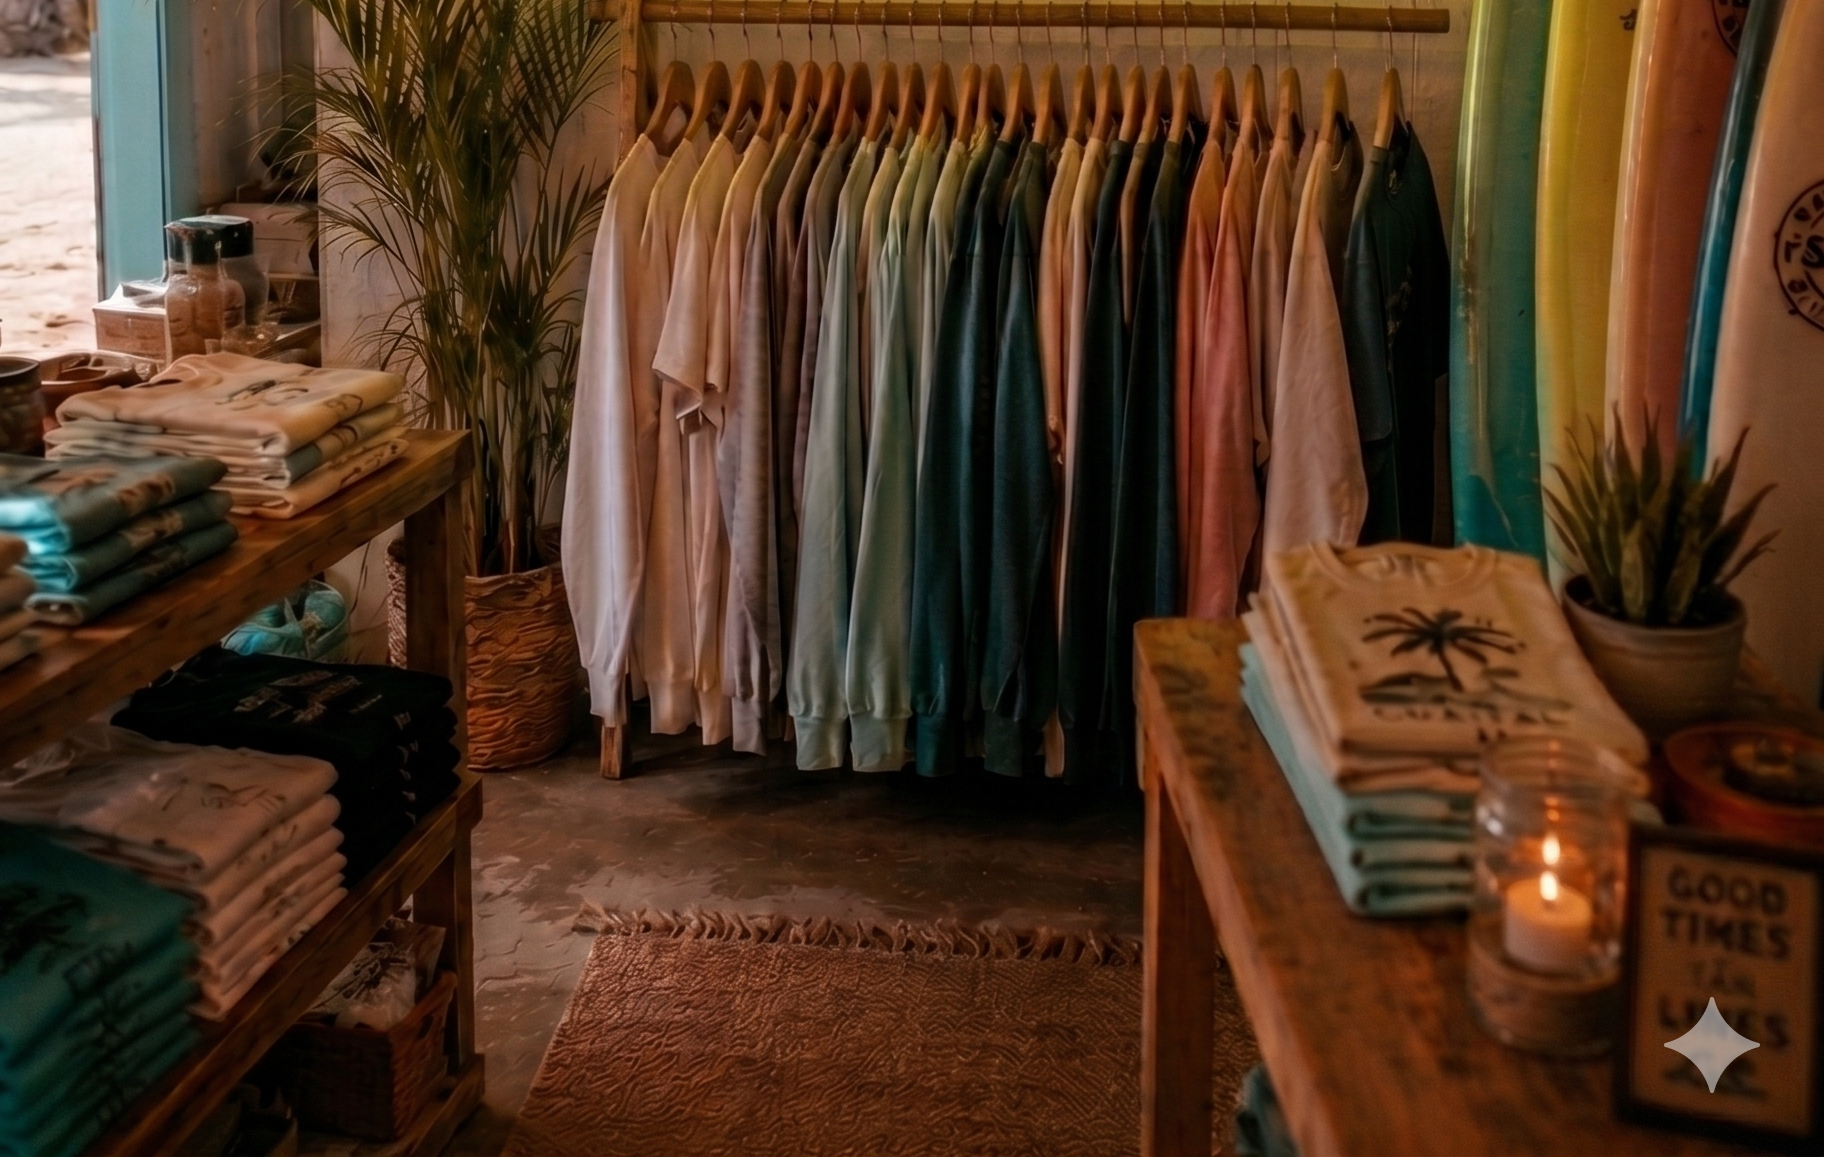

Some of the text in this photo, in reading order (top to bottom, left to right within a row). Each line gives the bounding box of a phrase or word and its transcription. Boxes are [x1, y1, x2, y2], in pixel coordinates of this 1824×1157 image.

[1668, 864, 1787, 916] GOOD
[1660, 906, 1791, 961] TIMES
[1658, 993, 1790, 1051] LIES
